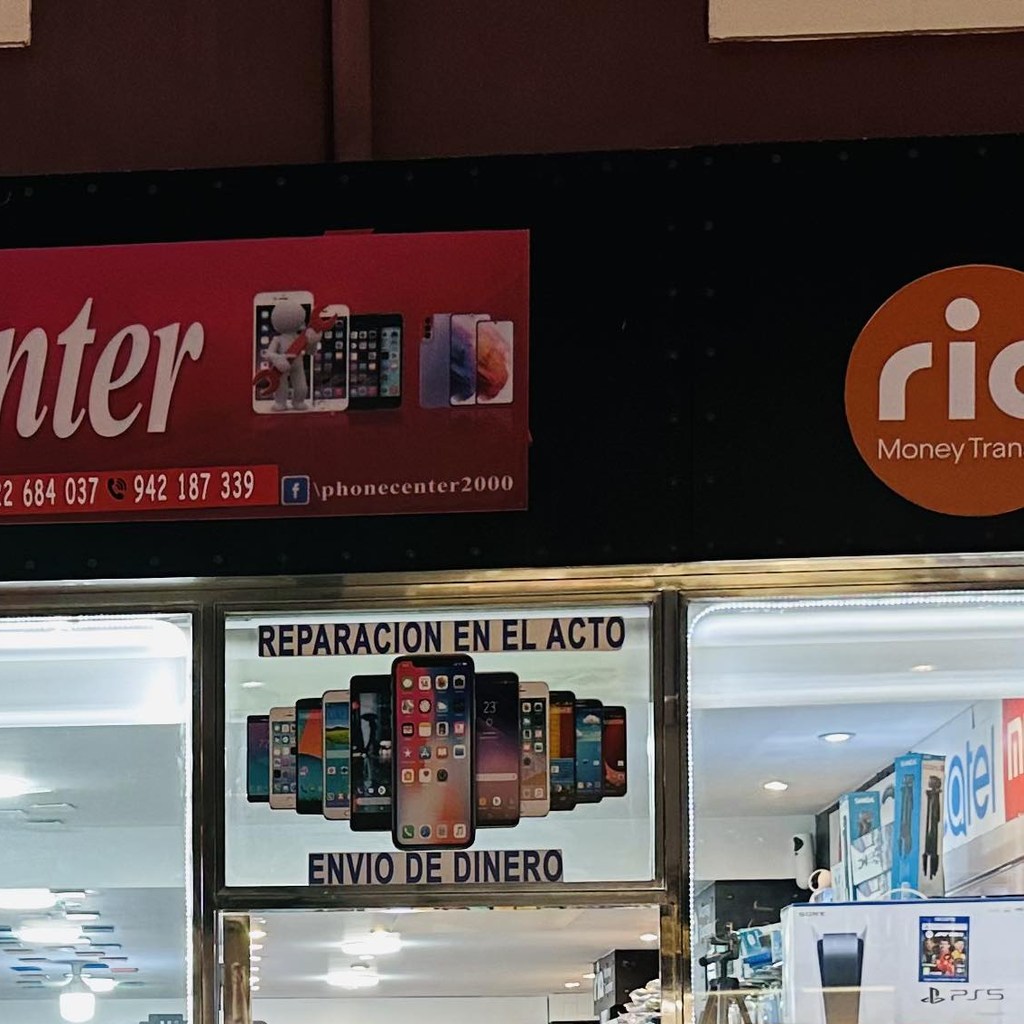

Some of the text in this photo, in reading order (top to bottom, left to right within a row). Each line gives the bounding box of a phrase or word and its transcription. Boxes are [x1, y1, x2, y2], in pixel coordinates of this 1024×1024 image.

[878, 437, 1024, 464] Money Tran
[22, 476, 57, 508] 684
[64, 475, 99, 506] 037
[133, 470, 255, 503] 942 187 339
[259, 616, 627, 657] REPARACION EN EL ACTO
